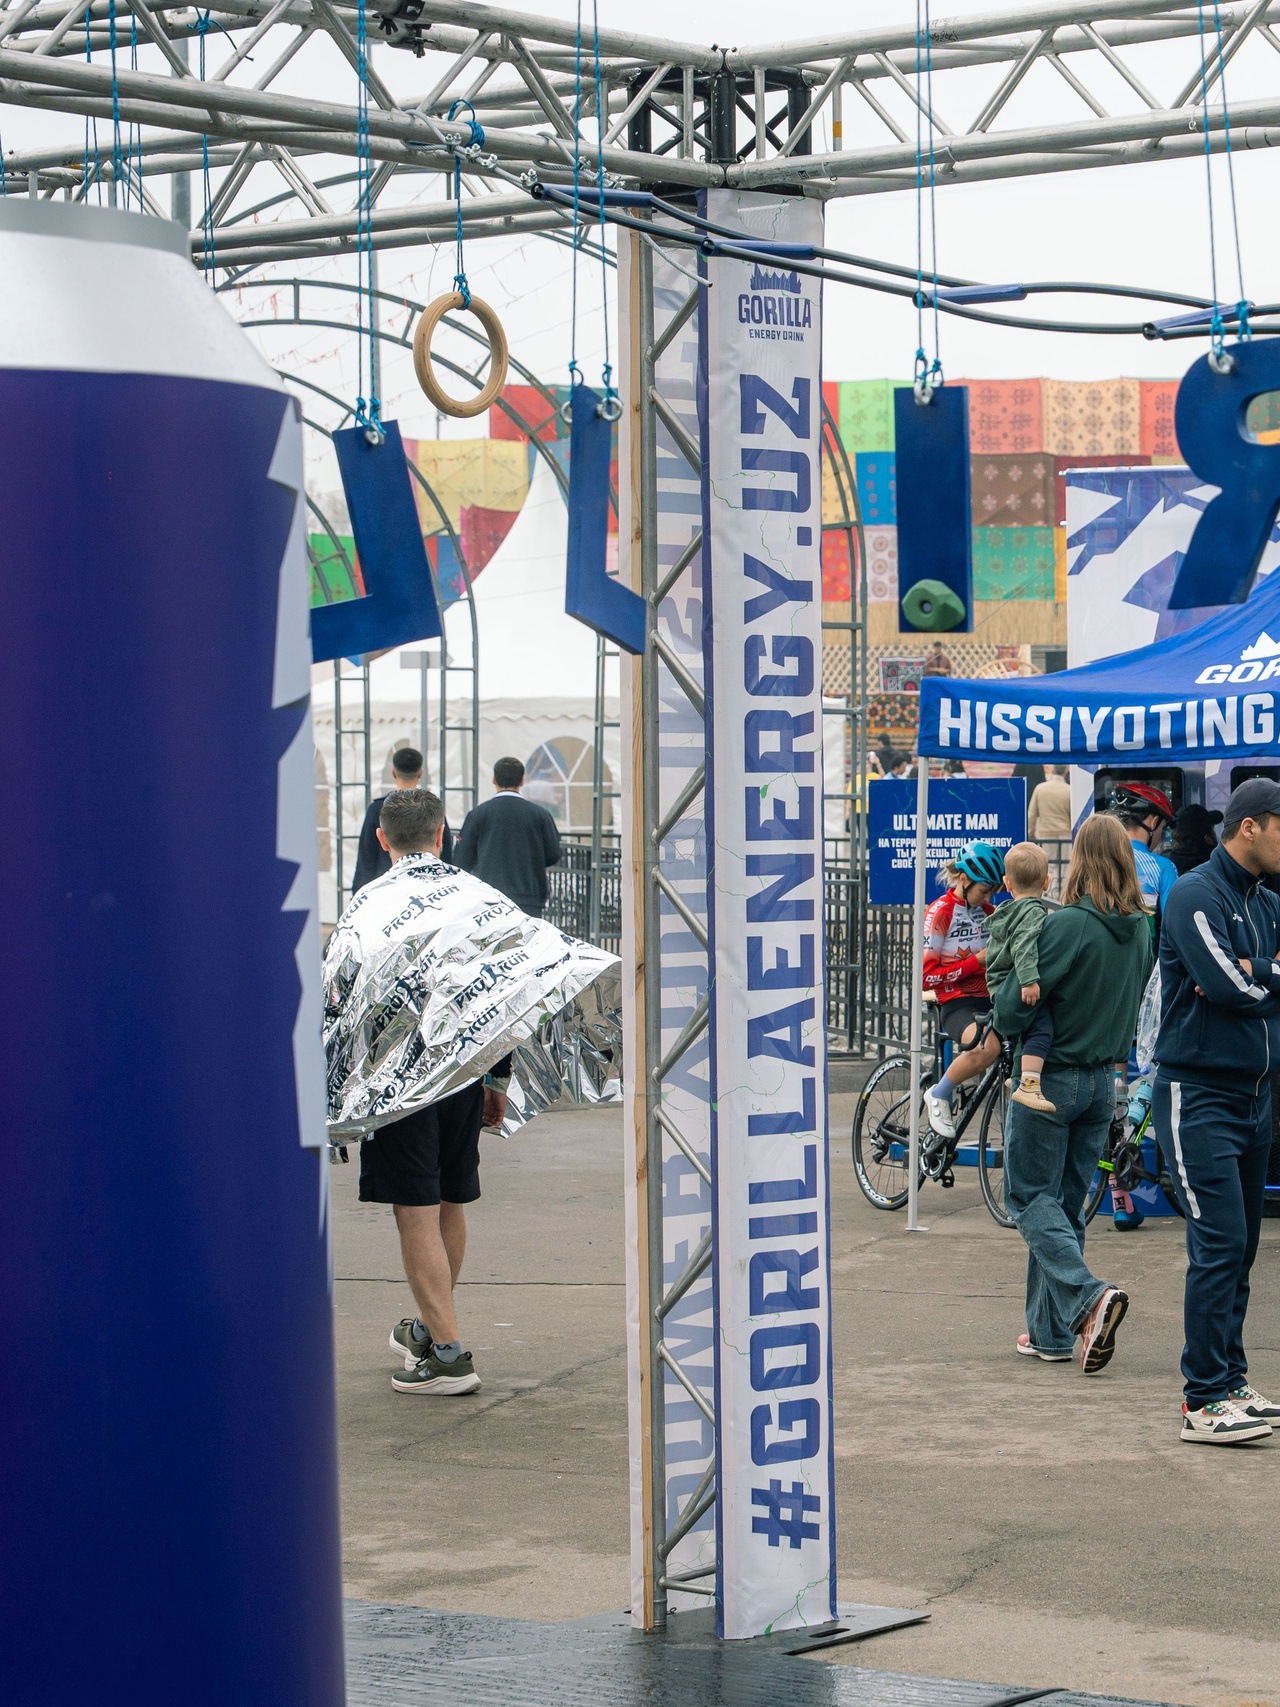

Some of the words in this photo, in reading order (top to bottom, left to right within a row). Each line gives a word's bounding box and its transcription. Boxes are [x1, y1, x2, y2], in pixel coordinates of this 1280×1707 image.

[738, 294, 812, 328] GORILLA
[749, 329, 781, 340] ENERGY
[783, 330, 805, 342] DRINK
[893, 814, 962, 830] ULTMATE
[965, 813, 998, 830] MAN
[878, 838, 889, 848] НА
[896, 849, 909, 859] ТЫ
[910, 848, 950, 859] МЖЕШЬ
[891, 857, 912, 868] СВОЁ
[739, 373, 820, 1551] #GORILLAENERGY.UZ
